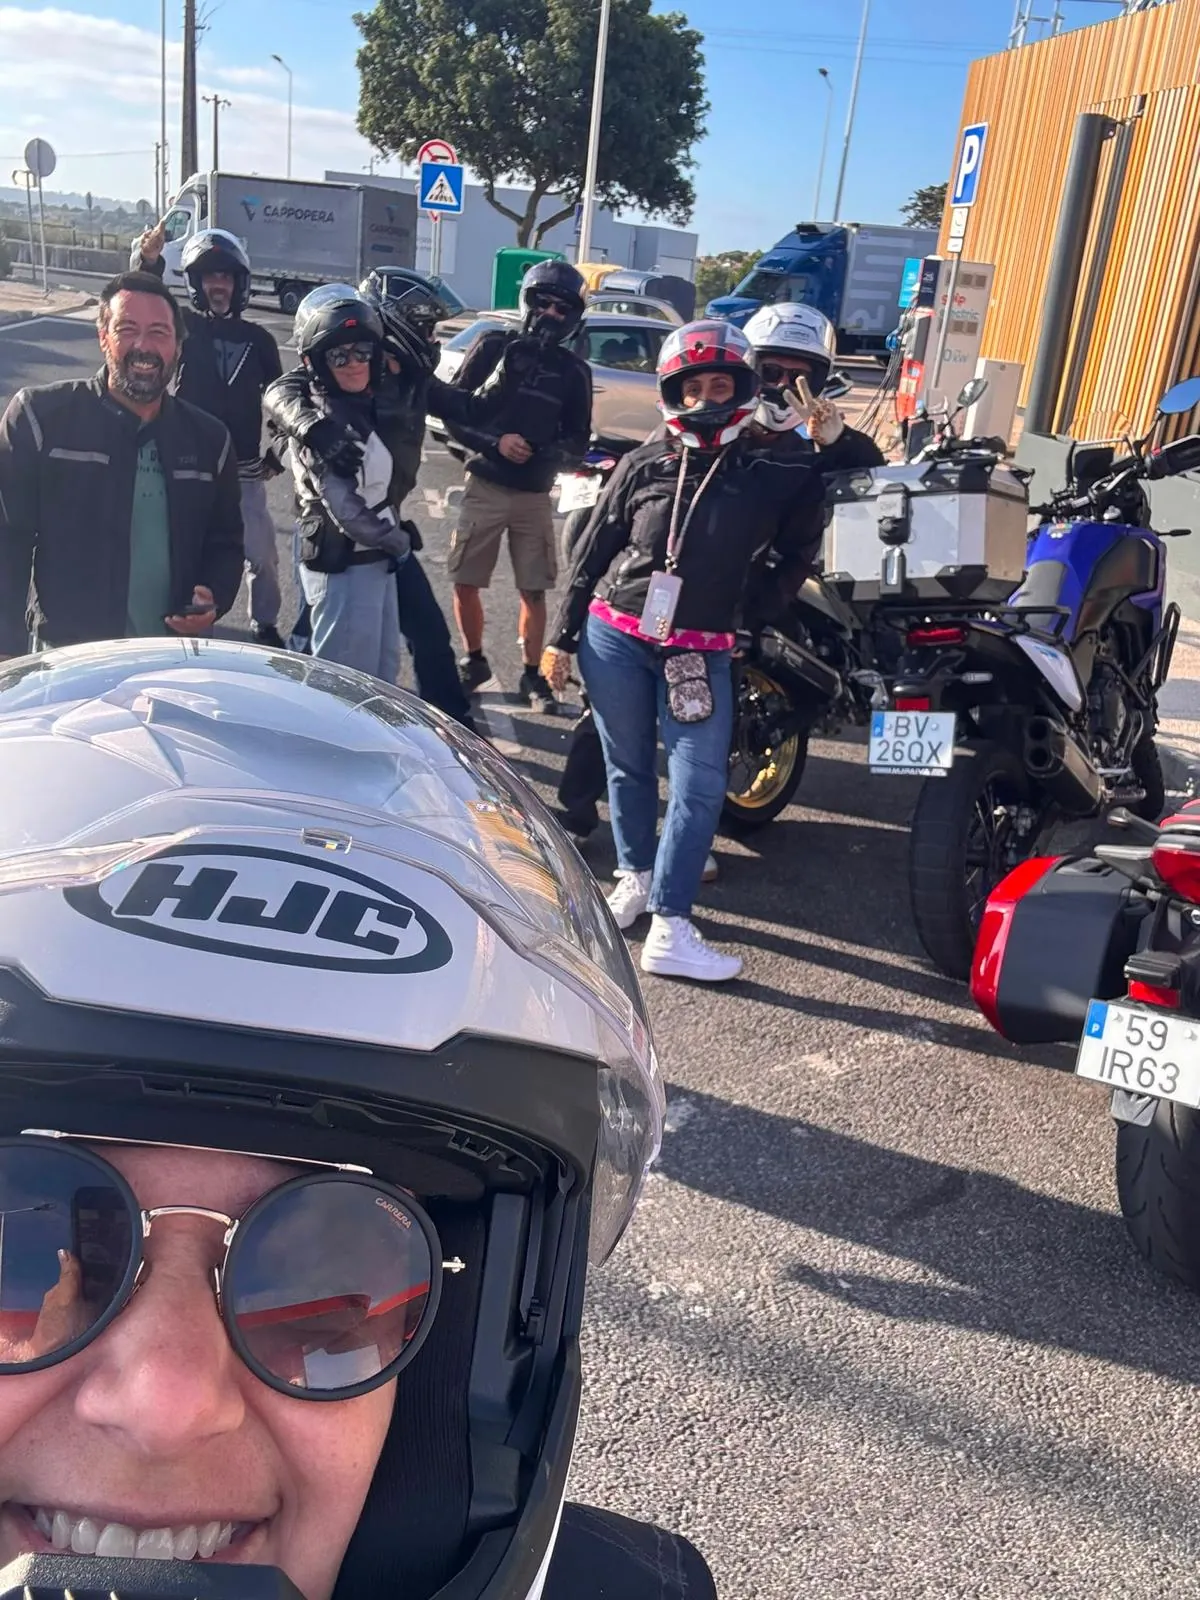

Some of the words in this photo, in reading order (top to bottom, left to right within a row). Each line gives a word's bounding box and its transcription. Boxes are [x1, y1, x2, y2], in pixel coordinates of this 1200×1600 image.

[955, 134, 980, 199] P
[263, 205, 335, 224] CAPPOPERA
[893, 715, 930, 739] BV
[876, 739, 943, 765] 26QX
[114, 862, 414, 956] HJC
[1091, 1023, 1100, 1034] P
[1125, 1013, 1169, 1052] 59
[1099, 1045, 1181, 1095] IR63
[375, 1197, 412, 1229] CARRERA
